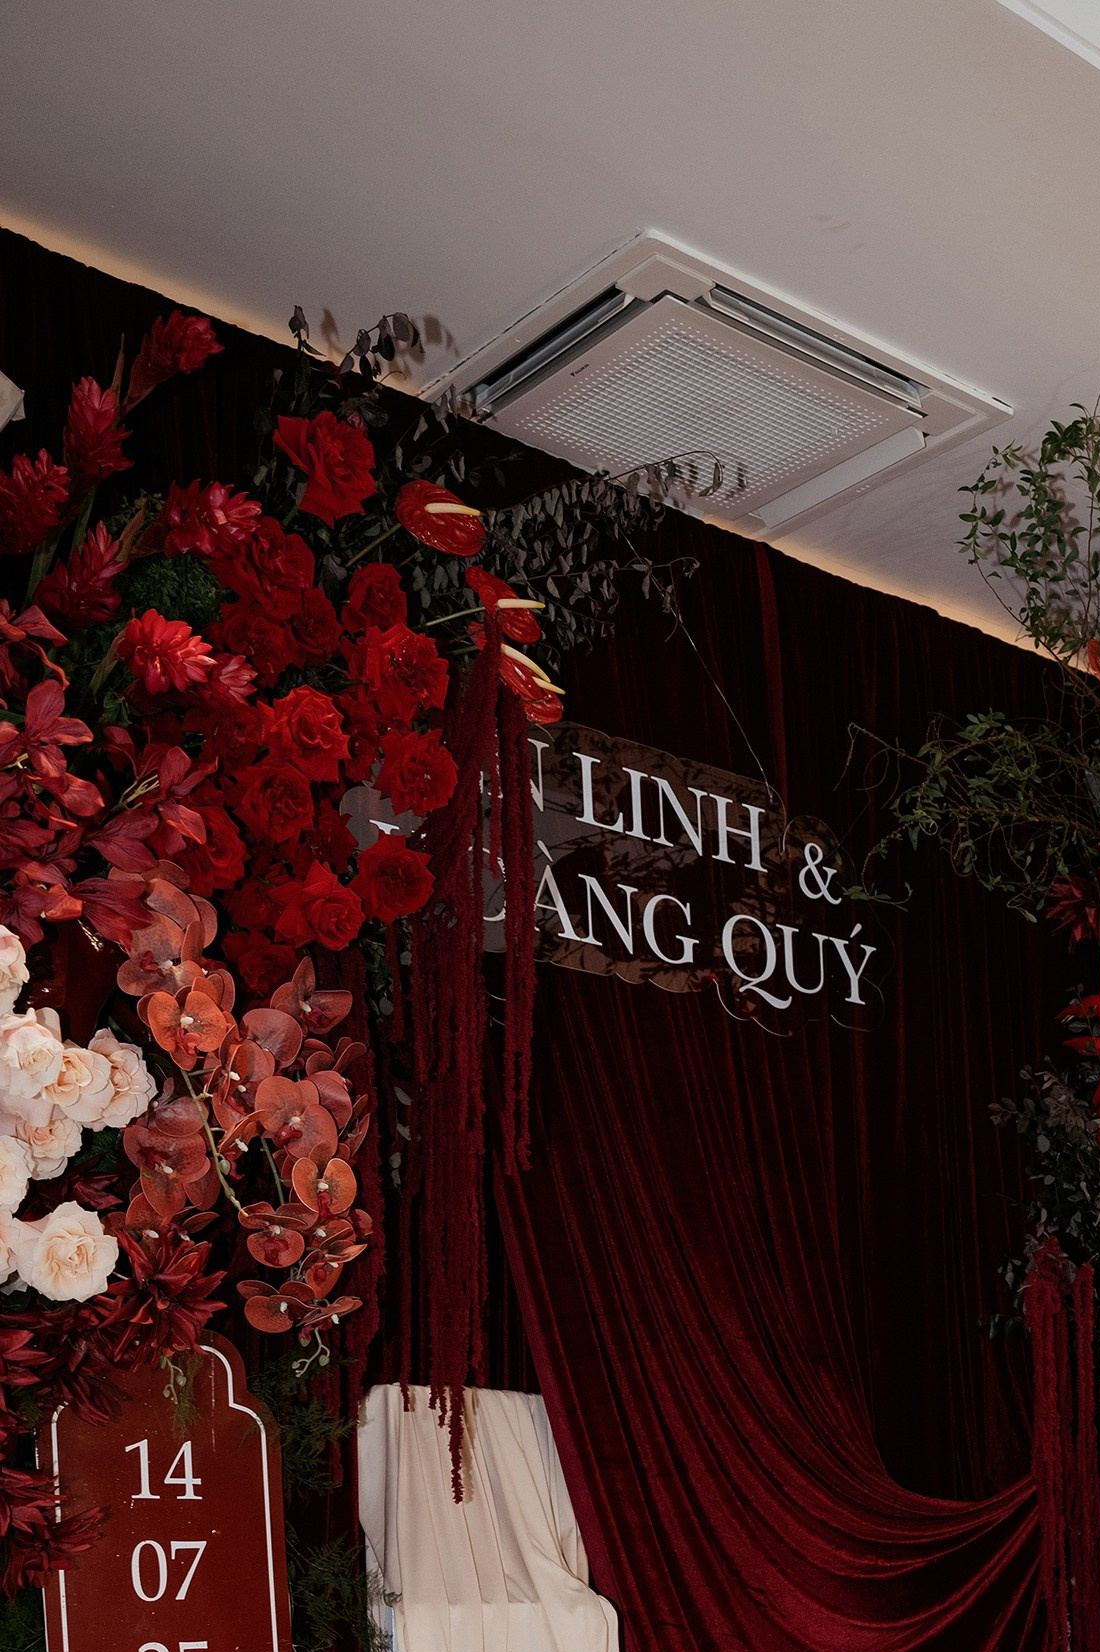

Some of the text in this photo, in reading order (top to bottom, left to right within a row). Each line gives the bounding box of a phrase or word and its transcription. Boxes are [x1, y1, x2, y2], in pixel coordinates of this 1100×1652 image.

[572, 752, 768, 873] LINH
[799, 842, 842, 905] &
[722, 914, 877, 1010] QUÝ
[124, 1438, 203, 1500] 14
[130, 1539, 207, 1602] 07
